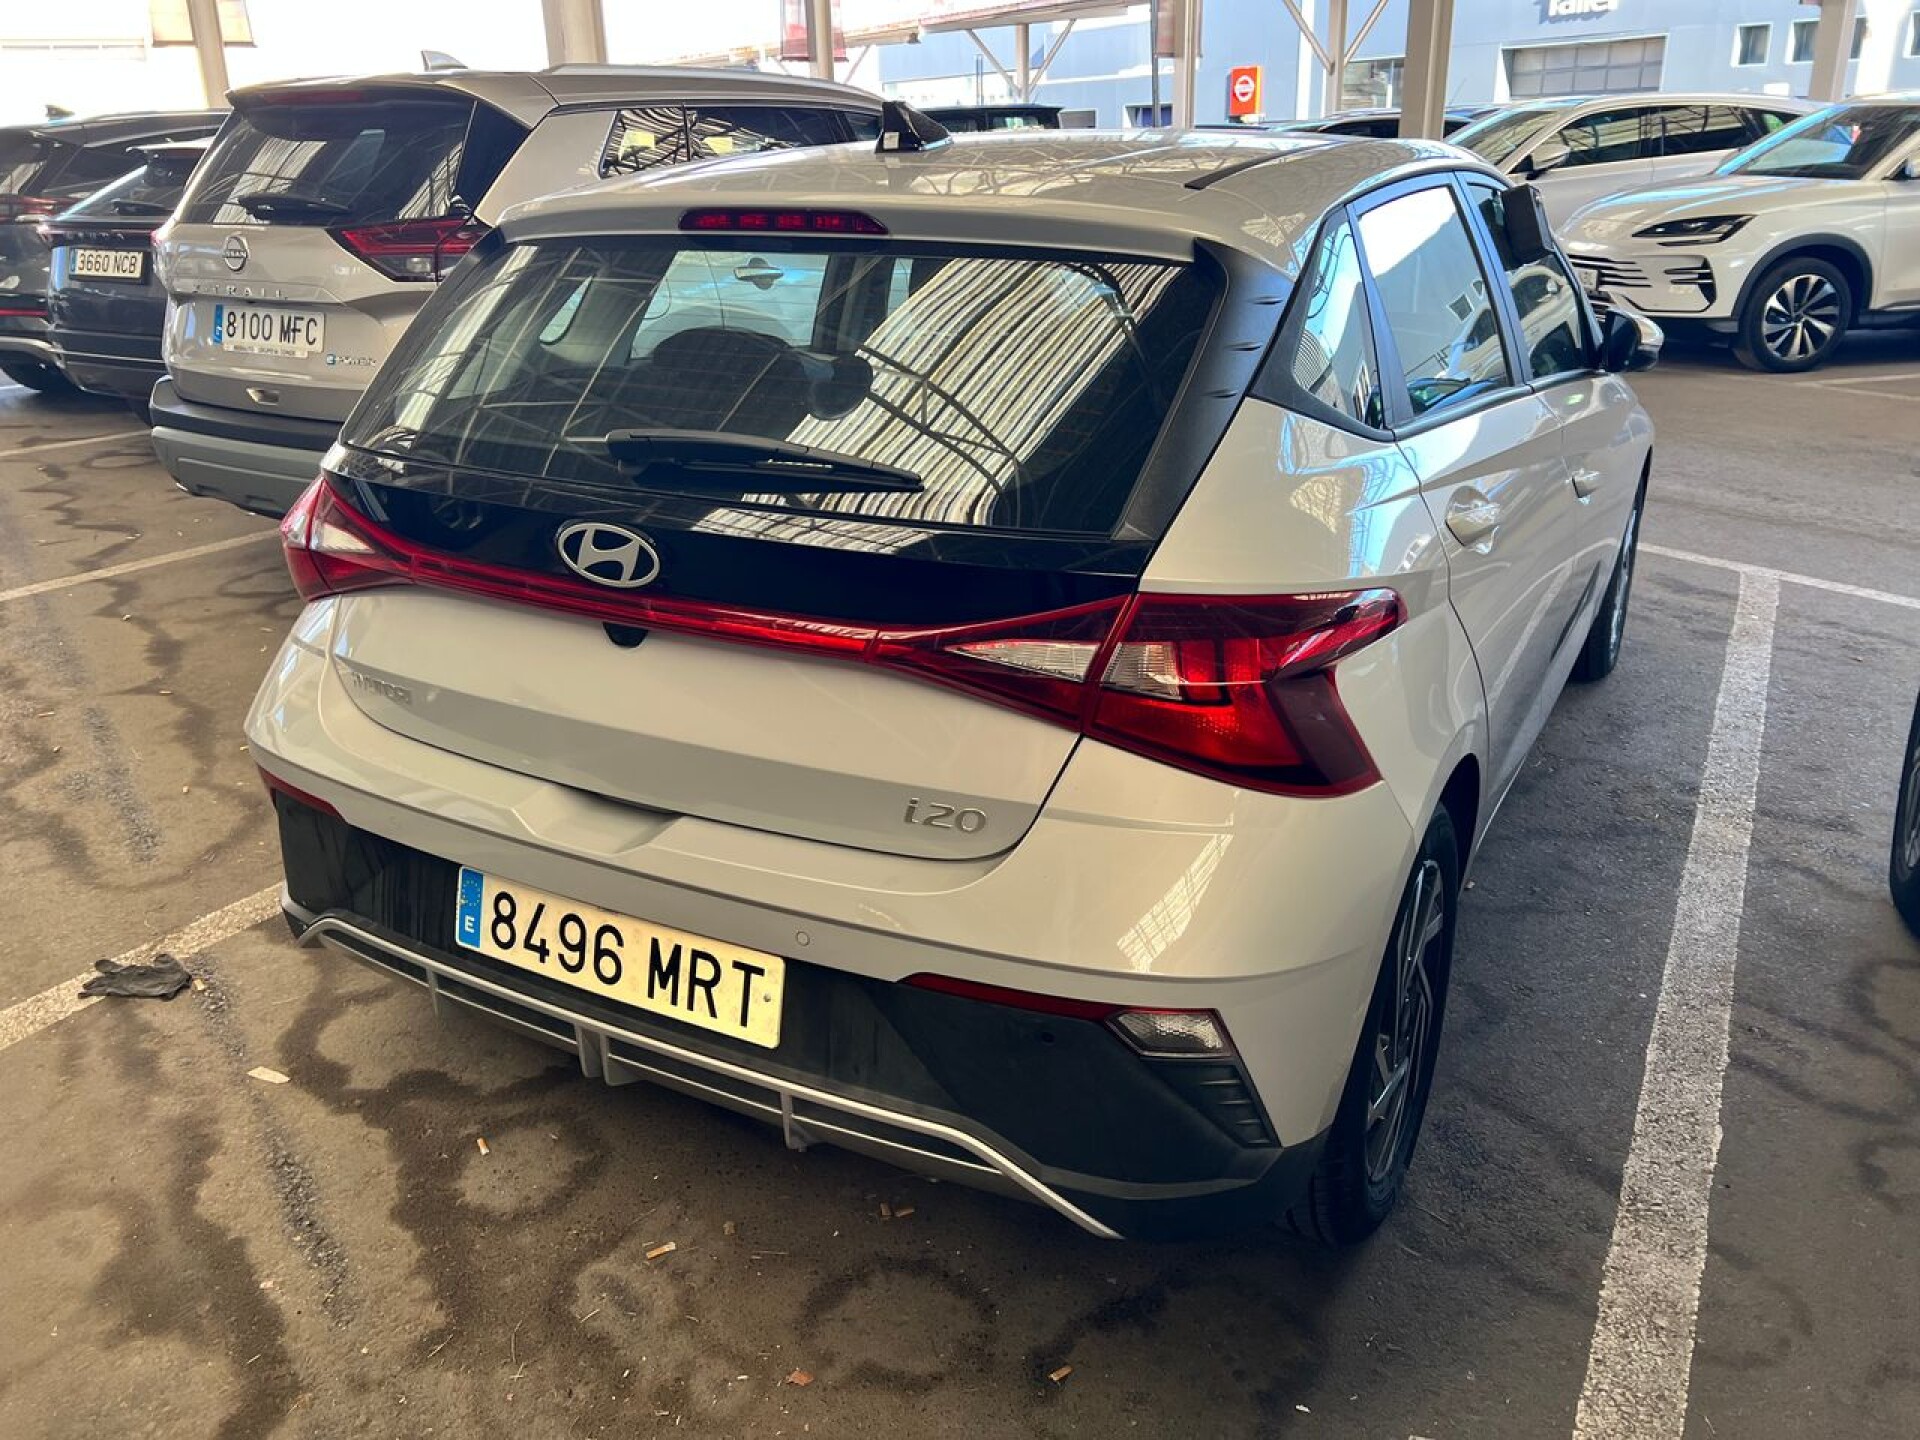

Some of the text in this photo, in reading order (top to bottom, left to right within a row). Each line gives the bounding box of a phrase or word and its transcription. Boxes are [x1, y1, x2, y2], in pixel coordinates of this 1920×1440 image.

[78, 253, 137, 273] 3660 NCB
[227, 311, 318, 346] 8100 MFC
[904, 797, 987, 833] i20
[464, 891, 766, 1028] E 8496 MRT
